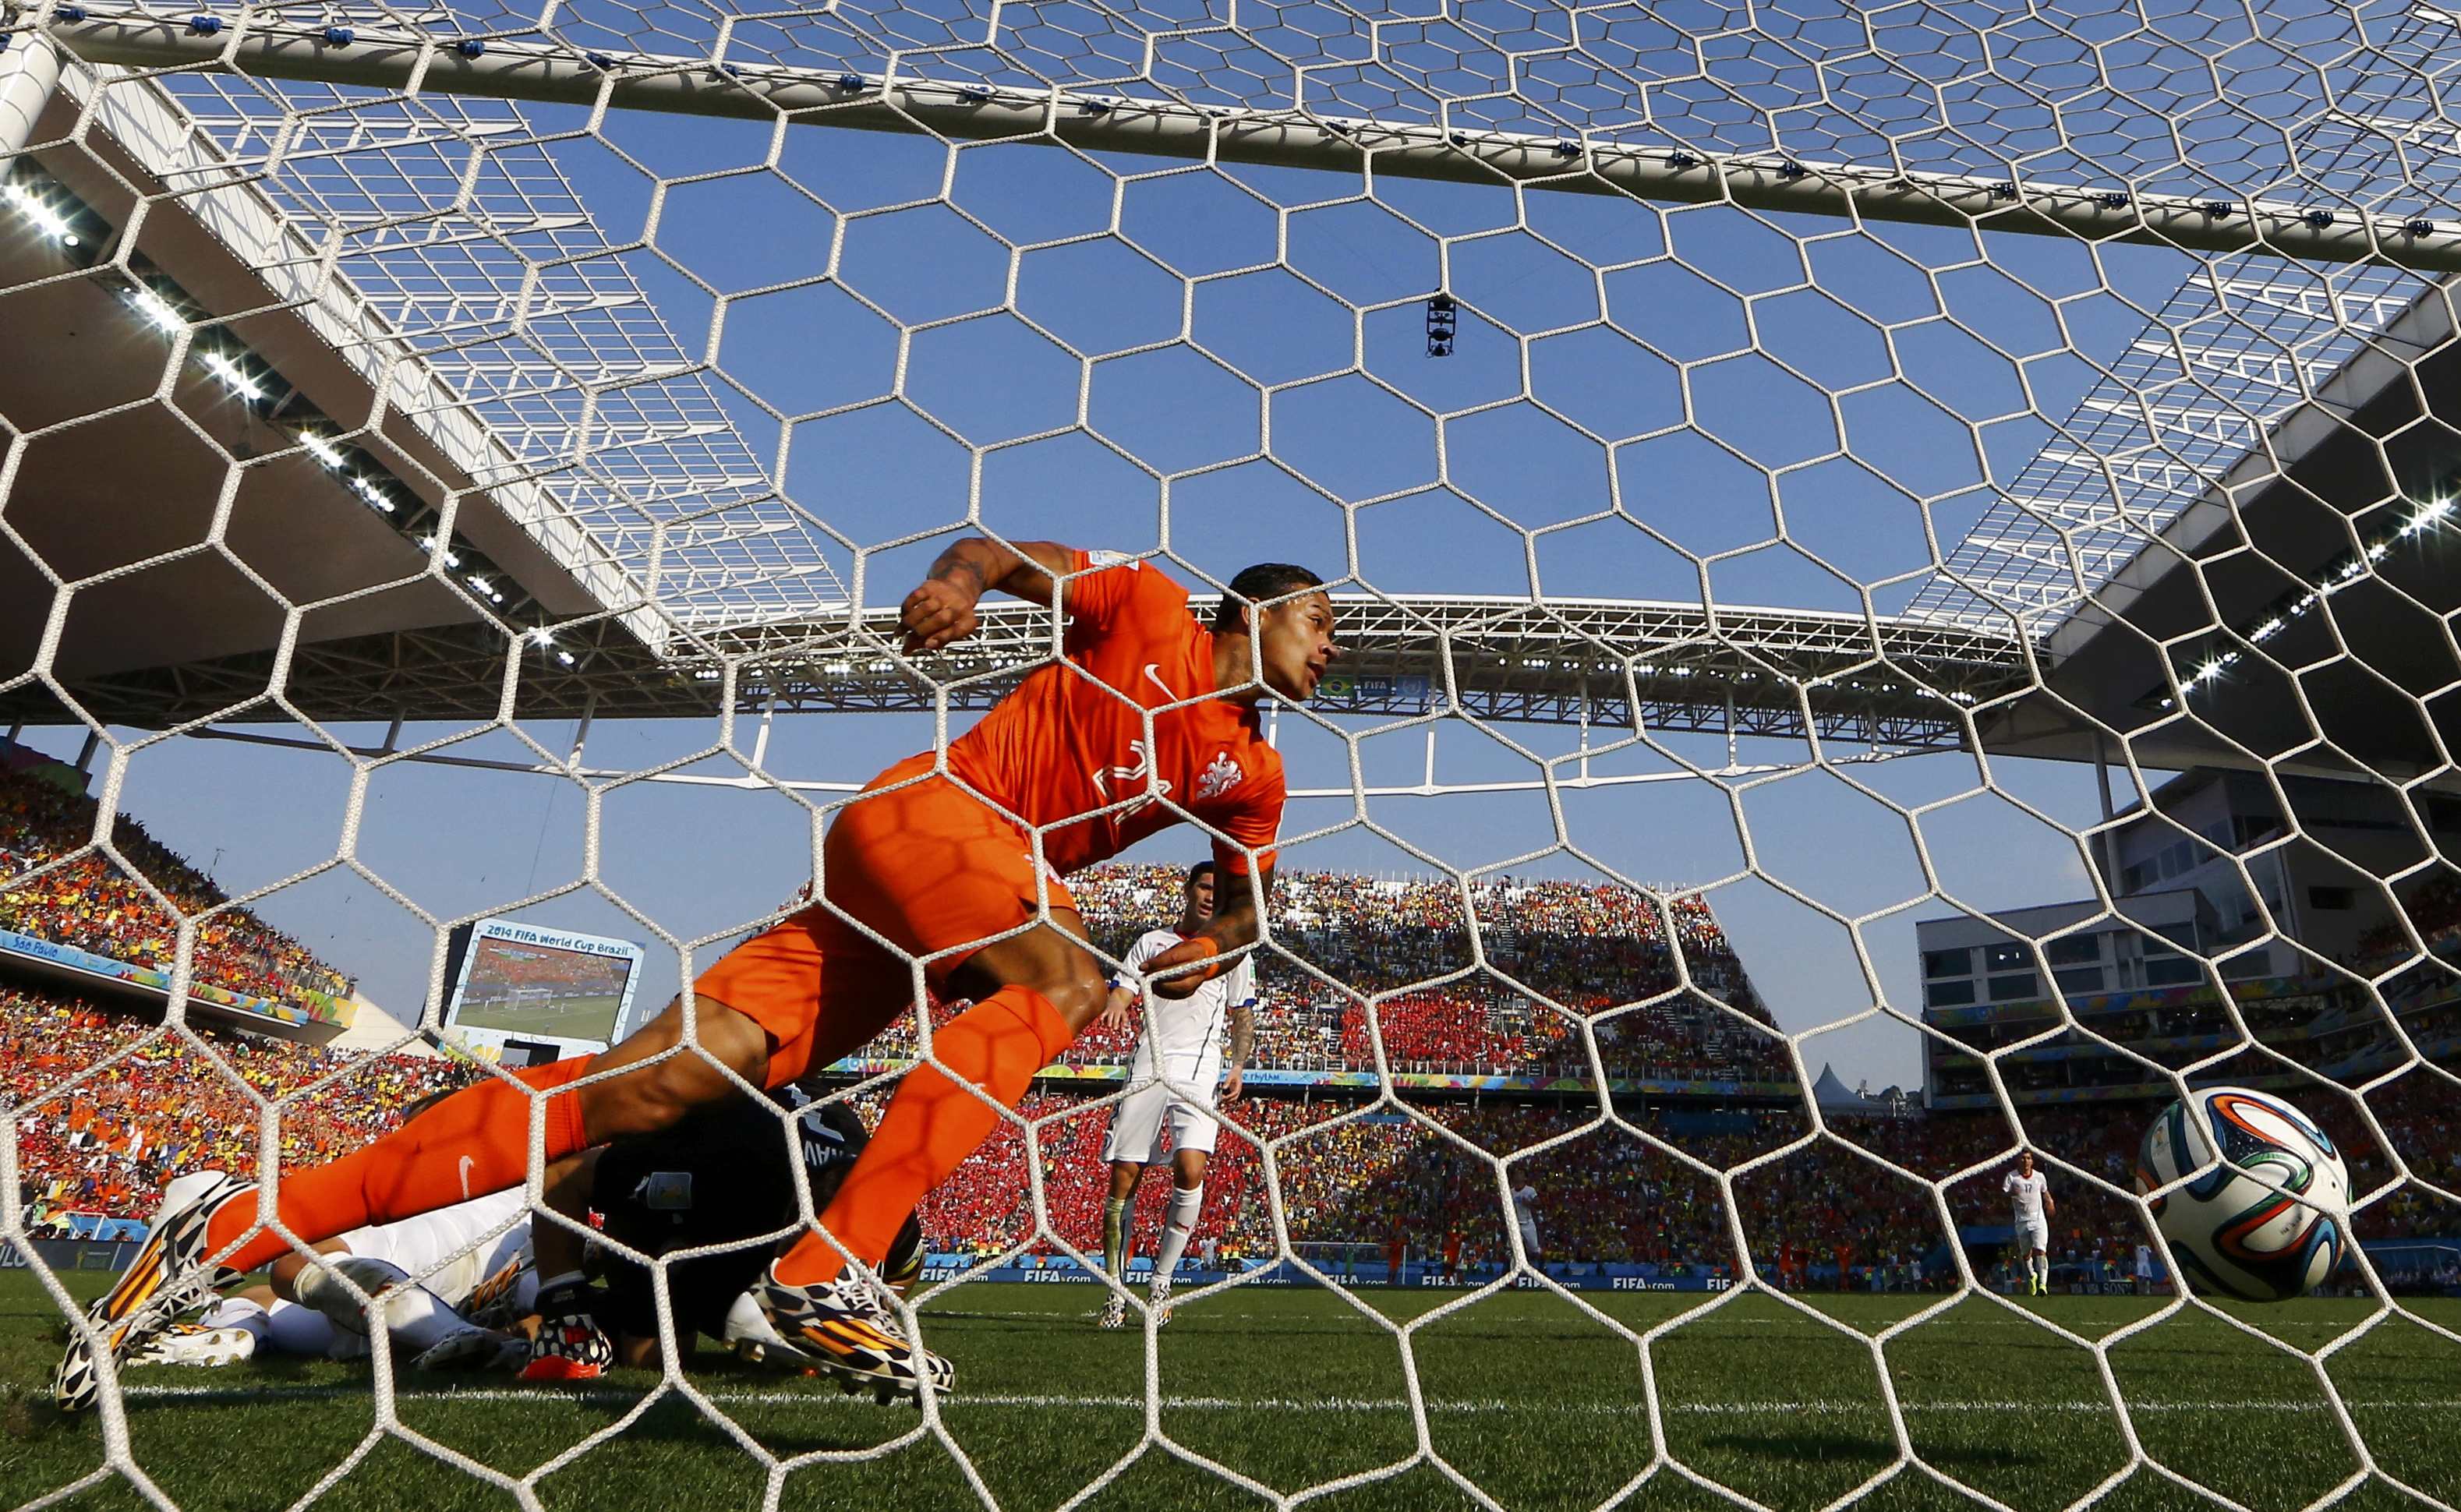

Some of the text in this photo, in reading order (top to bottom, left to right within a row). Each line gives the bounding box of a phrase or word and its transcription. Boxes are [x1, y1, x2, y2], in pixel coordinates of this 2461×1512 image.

[1364, 680, 1387, 690] FIFA
[486, 924, 512, 937] 2014
[515, 929, 537, 942] FIFA
[539, 934, 571, 947] World
[574, 939, 595, 955] Cup
[34, 941, 58, 958] Paulo
[2024, 1184, 2032, 1193] 17
[1024, 1270, 1091, 1283] FIFA.com
[1613, 1277, 1675, 1290] FIFA.com
